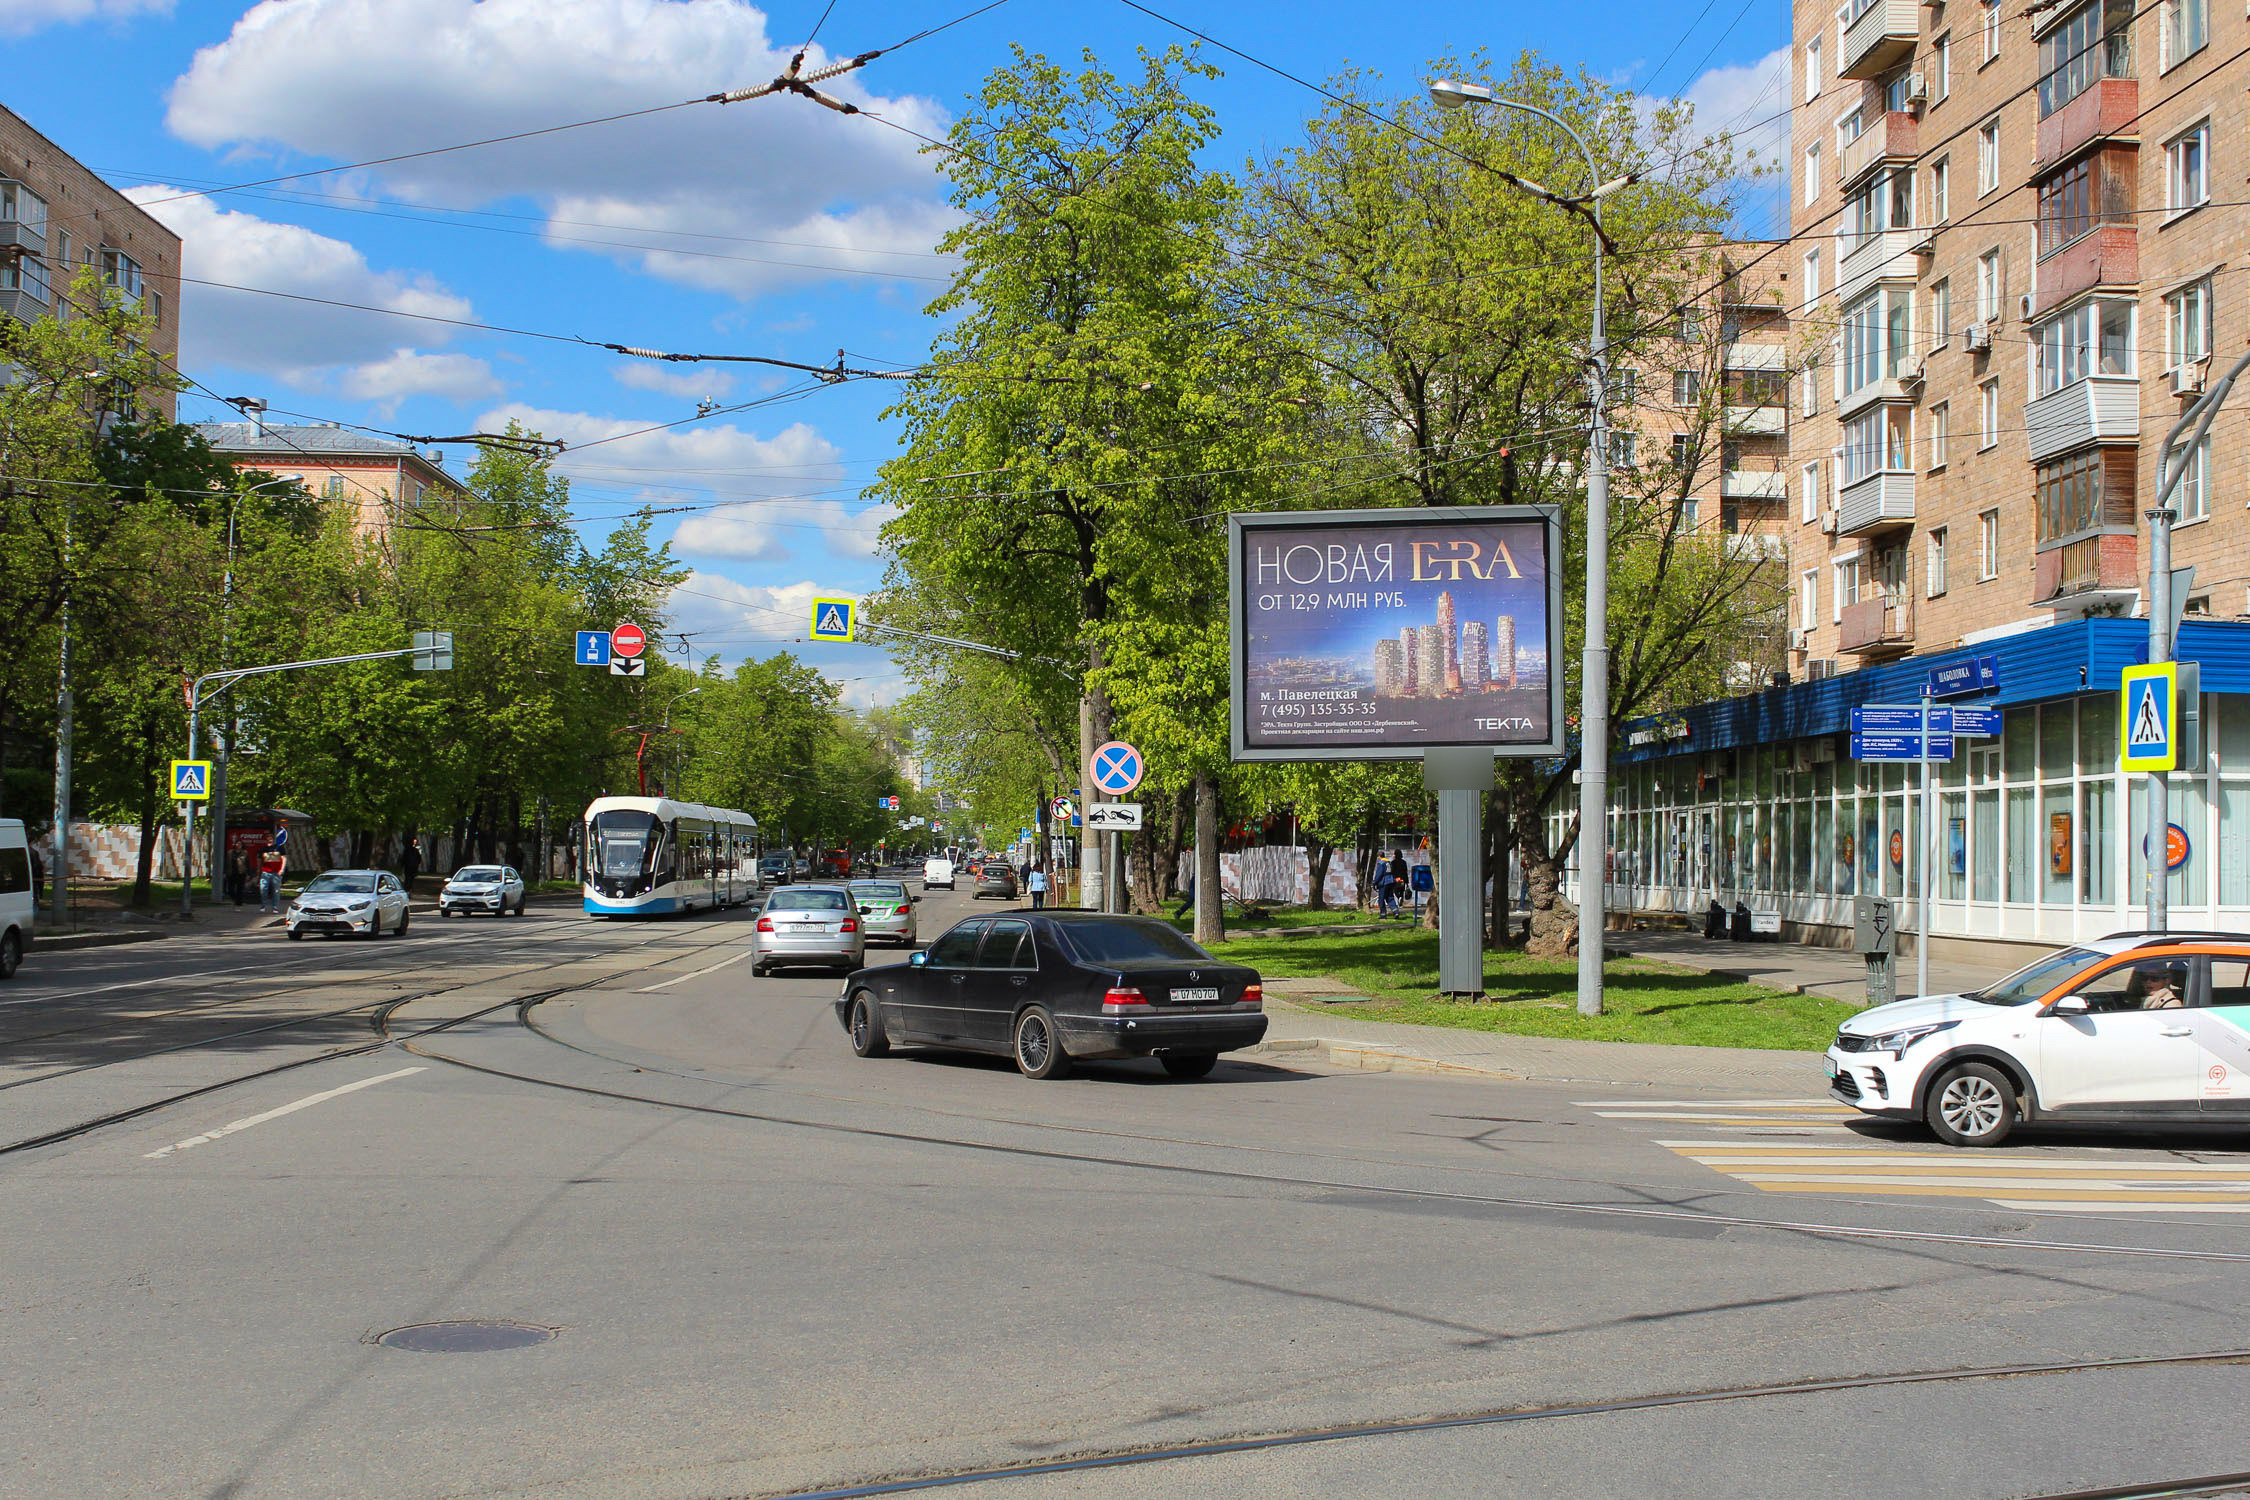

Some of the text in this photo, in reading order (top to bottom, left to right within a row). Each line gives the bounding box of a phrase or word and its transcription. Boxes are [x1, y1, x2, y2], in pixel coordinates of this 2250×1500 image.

[1258, 539, 1523, 585] НОВАЯ ERA
[1258, 591, 1407, 612] ОТ 12,9 МЛН РУБ.
[1938, 667, 1970, 683] ШАБОЛОВКА
[1260, 688, 1358, 701] м. Павелецкая
[1260, 702, 1377, 718] 7 (495) 135-35-35
[1473, 717, 1534, 730] ТЕКТА
[1260, 728, 1291, 736] Проектная
